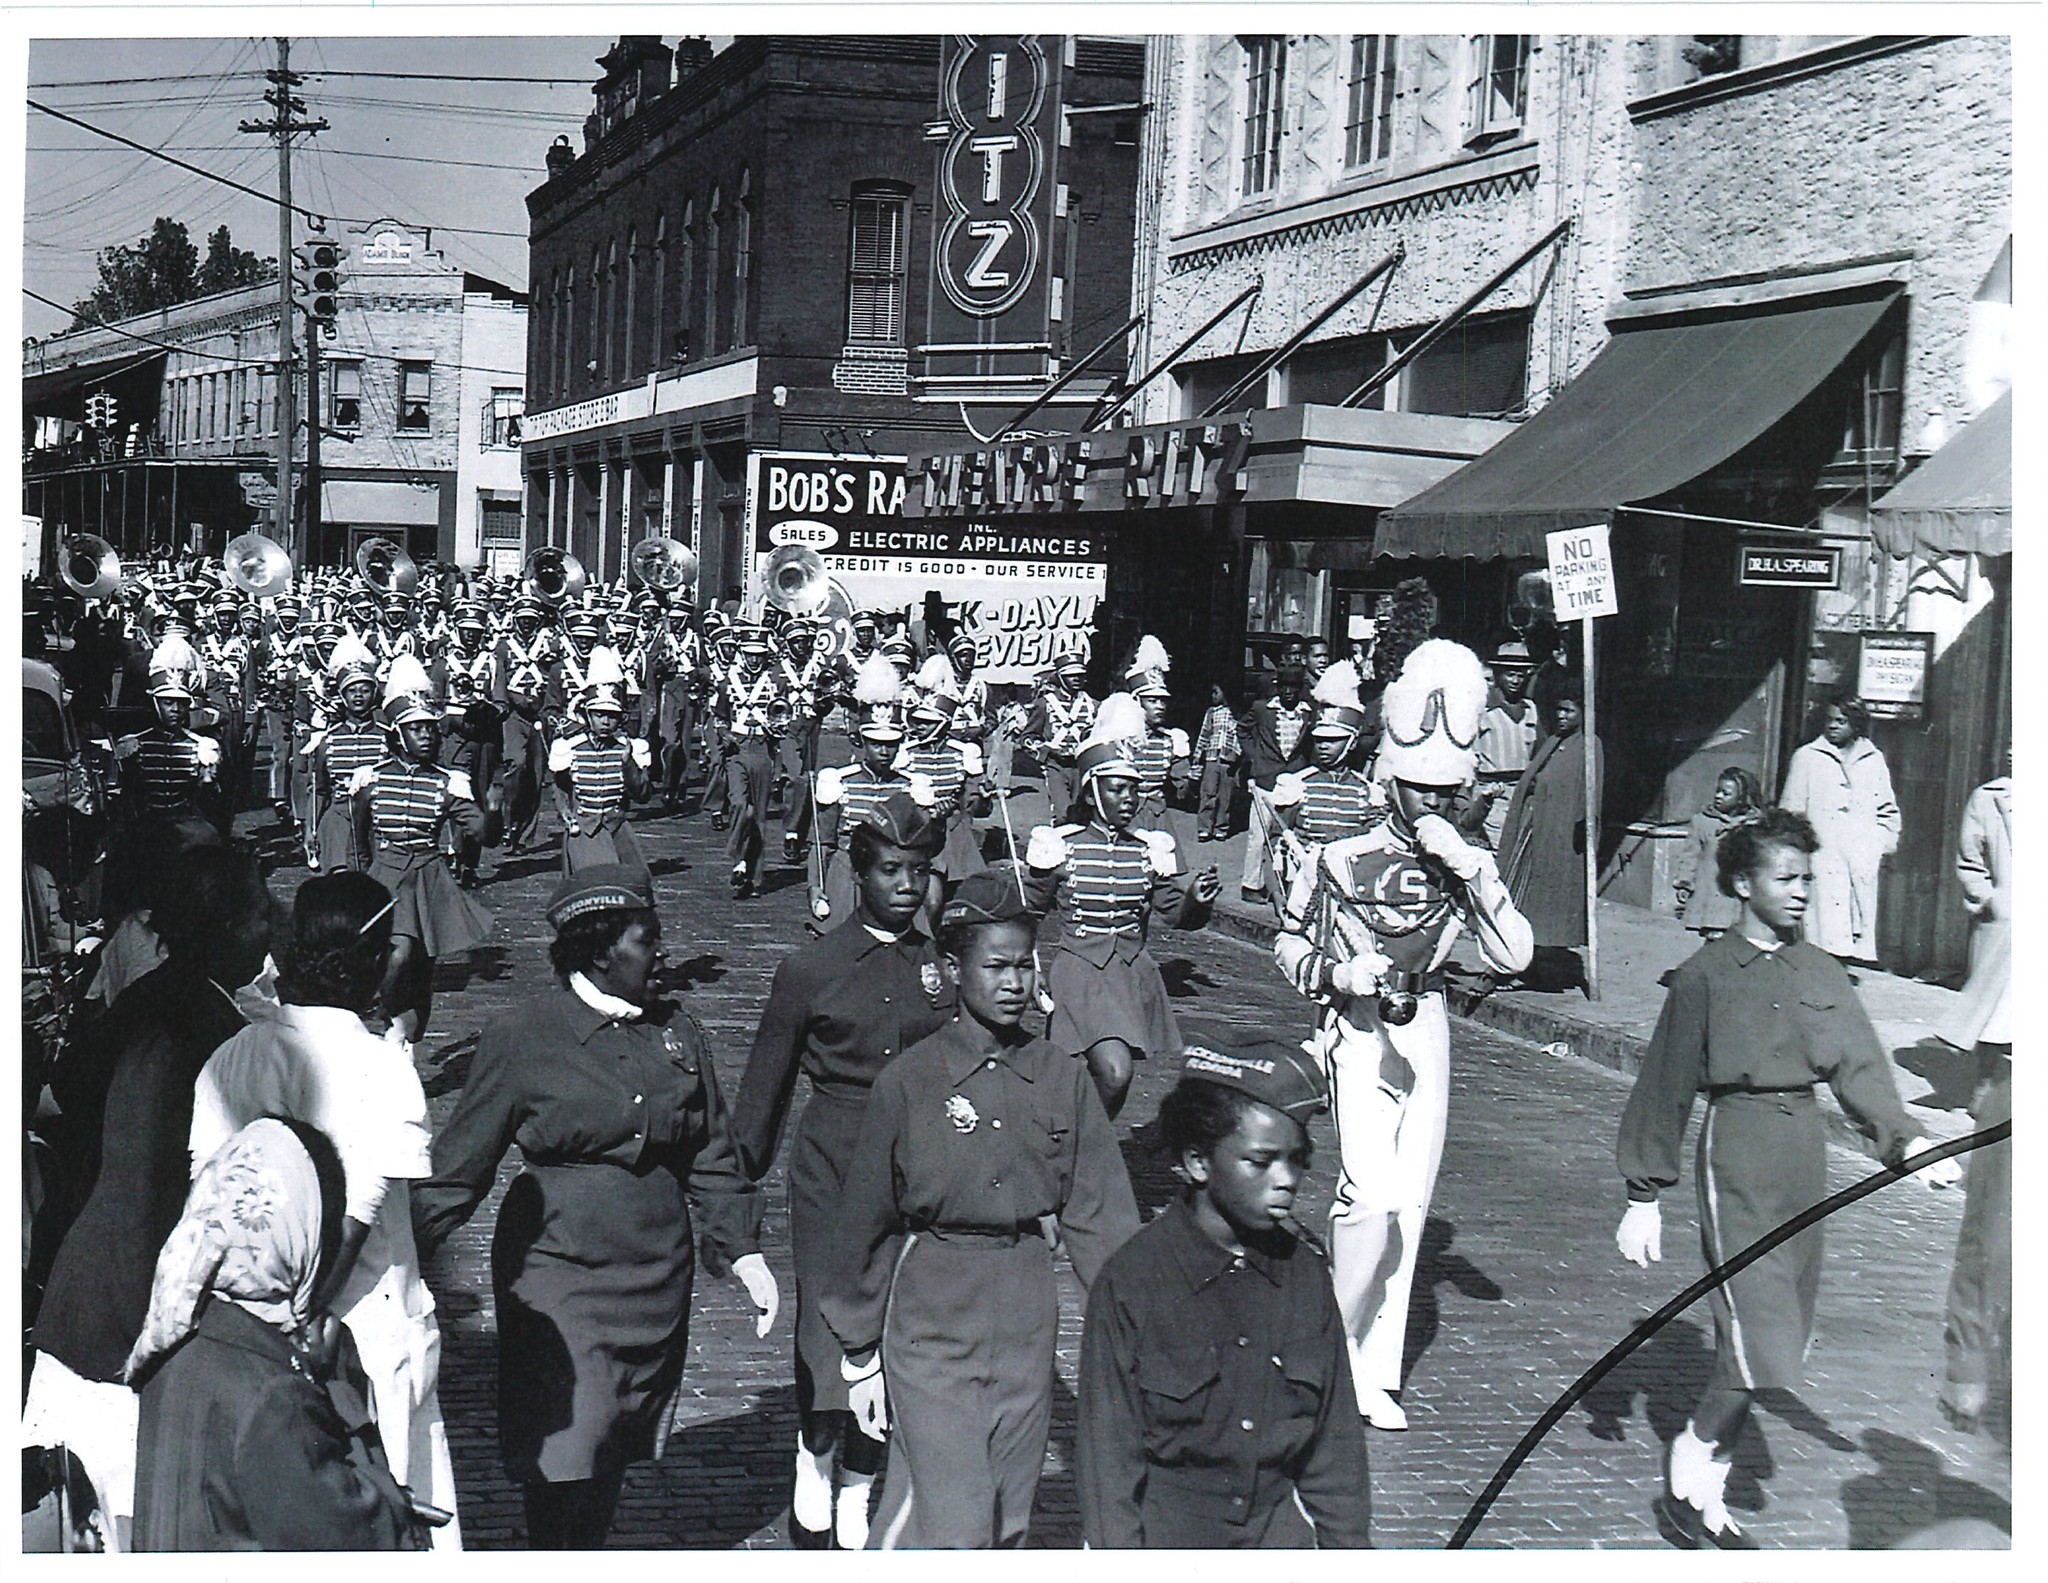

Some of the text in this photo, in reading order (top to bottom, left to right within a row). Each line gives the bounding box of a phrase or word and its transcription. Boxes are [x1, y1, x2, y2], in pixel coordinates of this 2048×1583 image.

[1123, 422, 1254, 498] RITZ
[768, 467, 856, 514] BOB'S
[780, 529, 827, 541] SALES
[850, 531, 1091, 556] ELECTRIC APPLIANCES
[1563, 538, 1593, 561] NO
[824, 557, 890, 572] CREDIT
[898, 561, 913, 574] IS
[920, 562, 965, 575] GOOD
[985, 564, 1018, 577] OUR
[1026, 565, 1096, 579] SERVICE
[1555, 558, 1608, 578] PARKING
[1556, 575, 1607, 592] AT ANY
[1567, 588, 1604, 608] TIME
[1400, 869, 1428, 911] S
